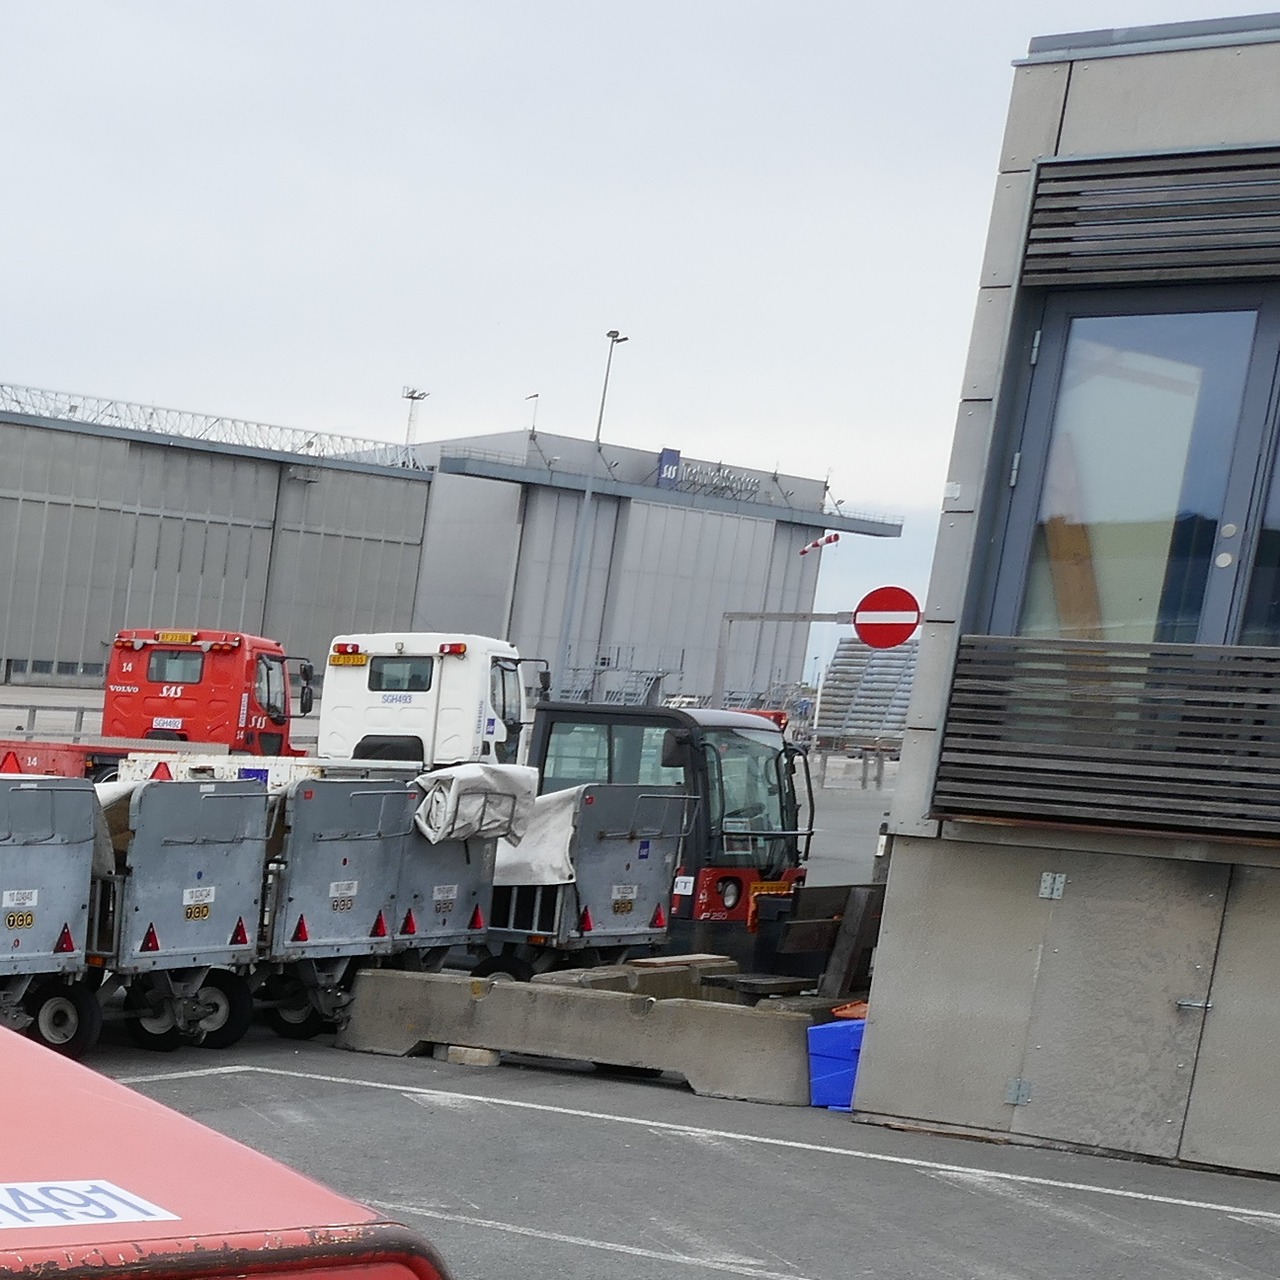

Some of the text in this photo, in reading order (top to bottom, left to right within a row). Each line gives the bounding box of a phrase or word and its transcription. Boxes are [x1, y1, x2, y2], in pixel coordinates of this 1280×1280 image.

[122, 662, 133, 672] 14
[109, 685, 139, 693] VOLVO
[159, 685, 184, 698] SAS
[381, 694, 412, 704] SGH493
[26, 756, 38, 766] 14
[8, 914, 32, 927] TCR
[711, 912, 728, 920] 250
